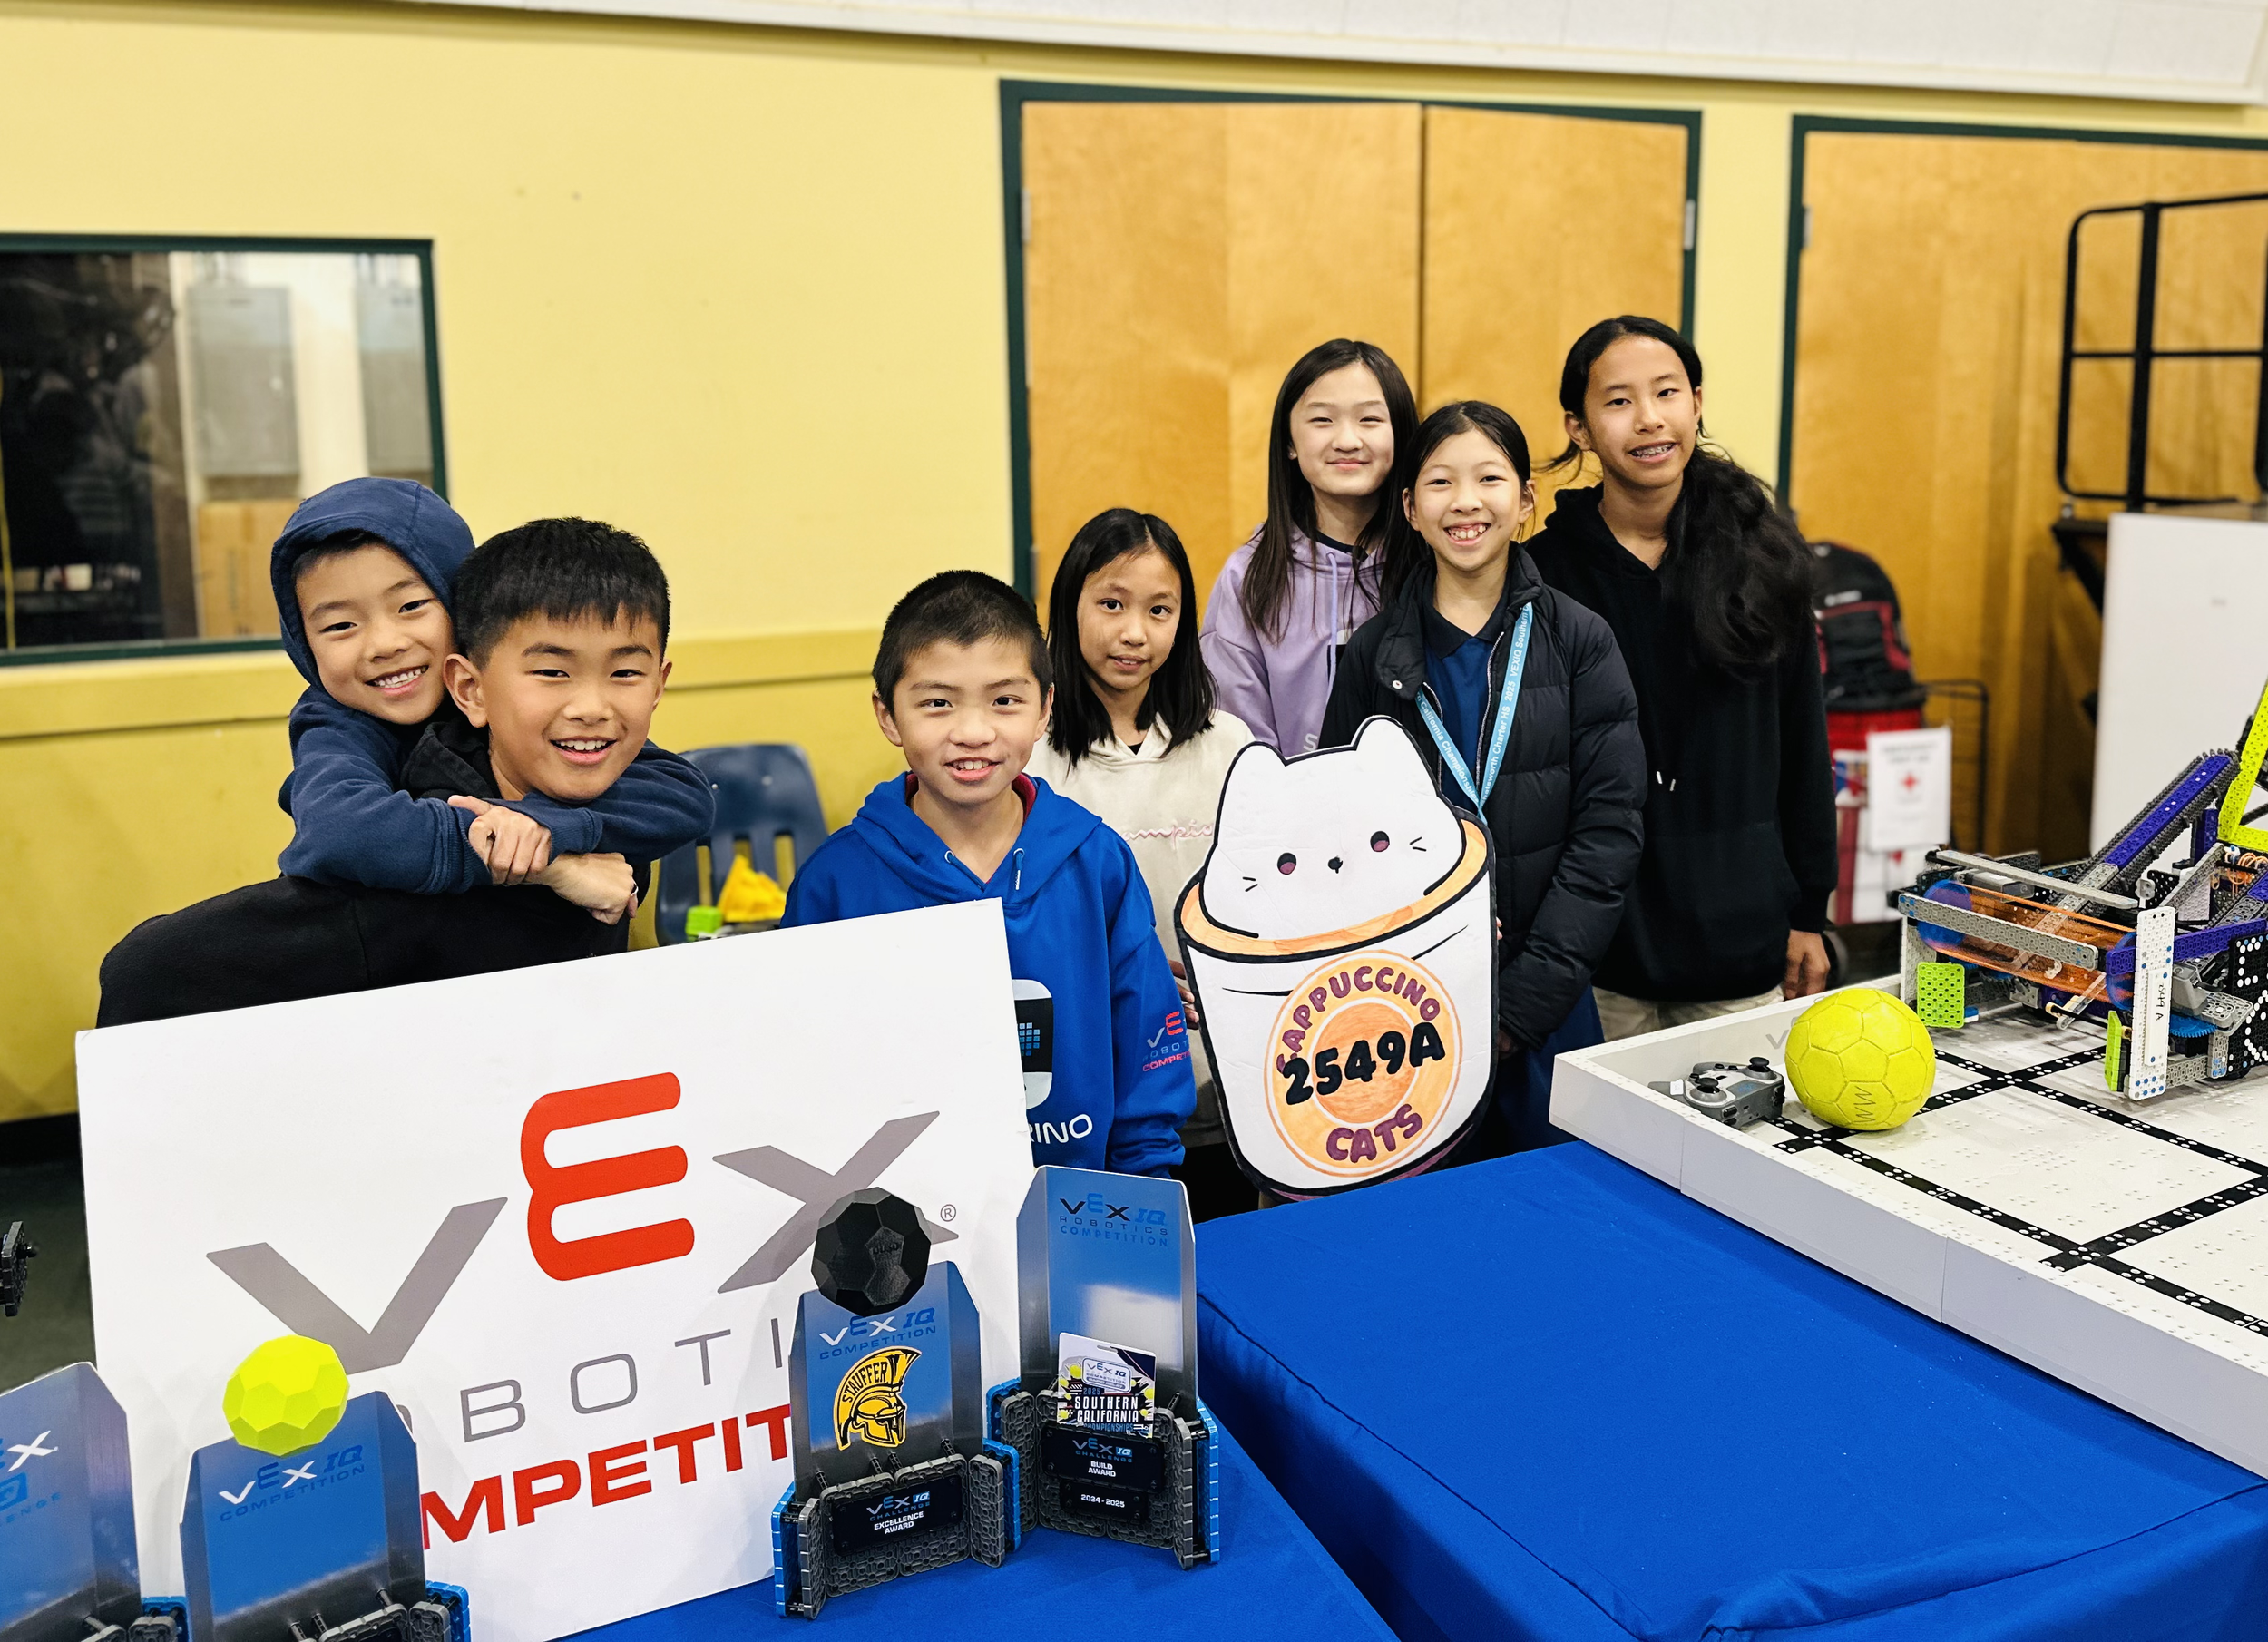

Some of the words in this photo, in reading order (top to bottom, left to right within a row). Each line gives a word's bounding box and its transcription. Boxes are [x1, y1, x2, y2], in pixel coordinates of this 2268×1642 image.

[1515, 612, 1529, 649] Southern
[1510, 650, 1523, 678] VEXIQ
[1504, 680, 1516, 702] 2025
[1420, 701, 1445, 741] California
[1501, 705, 1511, 719] HS
[1491, 718, 1508, 755] Charter
[1146, 1011, 1188, 1049] VE
[1282, 1022, 1446, 1106] 2549A
[1326, 1103, 1423, 1164] CATS
[1060, 1192, 1131, 1222] VEX
[1135, 1207, 1168, 1227] IQ
[206, 1071, 959, 1375] VEX
[1060, 1216, 1168, 1236] ROBOTICS
[1060, 1226, 1168, 1247] COMPETITION
[818, 1315, 897, 1347] VEX
[903, 1307, 936, 1329] IQ
[819, 1325, 937, 1361] COMPETITION
[843, 1361, 889, 1403] STAUFFER
[1087, 1363, 1112, 1375] VEX
[1114, 1370, 1127, 1378] IQ
[1083, 1387, 1101, 1395] 2025
[1074, 1396, 1138, 1410] SOUTHERN
[1077, 1409, 1139, 1423] CALIFORNIA
[1072, 1437, 1113, 1455] VEX
[1117, 1447, 1132, 1458] IQ
[1075, 1450, 1132, 1462] CHALLENGE
[219, 1461, 318, 1505] VEX
[323, 1444, 363, 1473] IQ
[420, 1403, 791, 1551] MPETIT
[1088, 1467, 1116, 1477] AWARD
[1090, 1461, 1113, 1470] BUILD
[220, 1464, 365, 1522] COMPETITION
[866, 1495, 910, 1515] VEX
[914, 1491, 930, 1503] IQ
[1080, 1493, 1100, 1503] 2024
[1105, 1498, 1125, 1508] 2025
[869, 1501, 930, 1521] CHALLENGE
[874, 1510, 924, 1530] EXCELLENCE
[885, 1520, 914, 1534] AWARD
